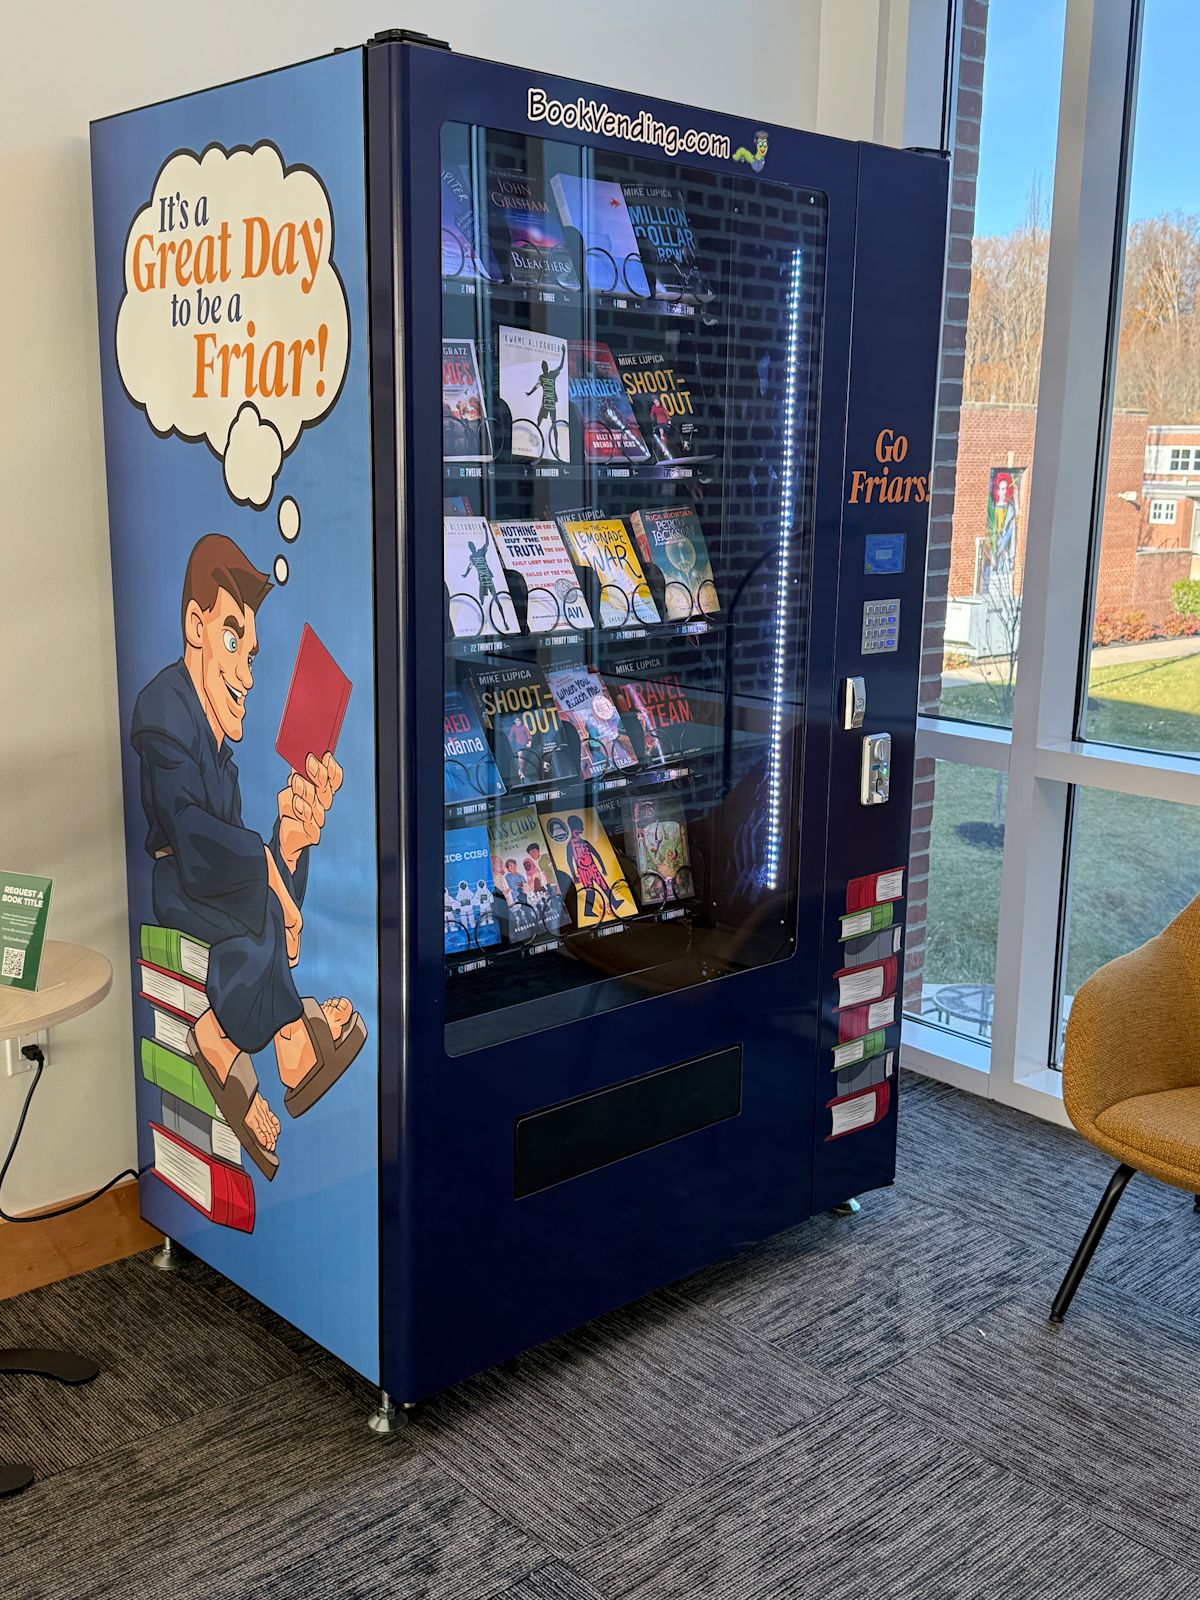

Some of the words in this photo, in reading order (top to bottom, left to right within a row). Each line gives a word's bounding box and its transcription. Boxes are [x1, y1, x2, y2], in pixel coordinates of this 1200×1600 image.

[527, 87, 730, 158] BookVending.com
[497, 178, 532, 196] JOHN
[623, 187, 643, 197] MIKE
[646, 188, 672, 199] LUPICA
[158, 191, 188, 233] It's
[194, 196, 209, 228] a
[491, 191, 549, 213] GRISHAM
[133, 222, 232, 292] Great
[241, 216, 323, 294] Day
[171, 293, 191, 328] to
[196, 288, 221, 325] be
[227, 293, 242, 322] a
[443, 347, 468, 356] GRATZ
[529, 338, 561, 352] ALEXANDER
[192, 320, 328, 397] Friar!
[618, 356, 637, 366] MIKE
[638, 354, 665, 365] LUPICA
[622, 369, 685, 396] SHOOT-
[660, 391, 694, 417] OUT
[875, 429, 908, 463] Go
[848, 466, 932, 504] Friars!
[578, 509, 606, 522] LUPICA
[645, 513, 662, 521] RICK
[499, 525, 537, 537] NOTHING
[573, 529, 627, 550] LEMONADE
[506, 544, 545, 557] TRUTH
[473, 556, 493, 587] BOOKED
[583, 545, 642, 579] WAR
[568, 606, 584, 619] AVI
[471, 644, 477, 652] 22
[477, 642, 493, 652] TWENTY
[494, 641, 503, 650] TWO
[479, 674, 500, 685] MIKE
[502, 669, 531, 682] LUPICA
[615, 662, 635, 675] MIKE
[636, 658, 661, 670] LUPICA
[556, 685, 578, 701] When
[575, 677, 591, 690] You
[619, 675, 685, 709] TRAVEL
[482, 684, 553, 716] SHOOT-
[522, 707, 559, 736] OUT
[646, 699, 694, 730] TEAM
[464, 849, 489, 862] case
[2, 894, 22, 905] BOOK
[24, 897, 44, 908] TITLE
[4, 886, 37, 898] REQUEST
[37, 891, 44, 899] A
